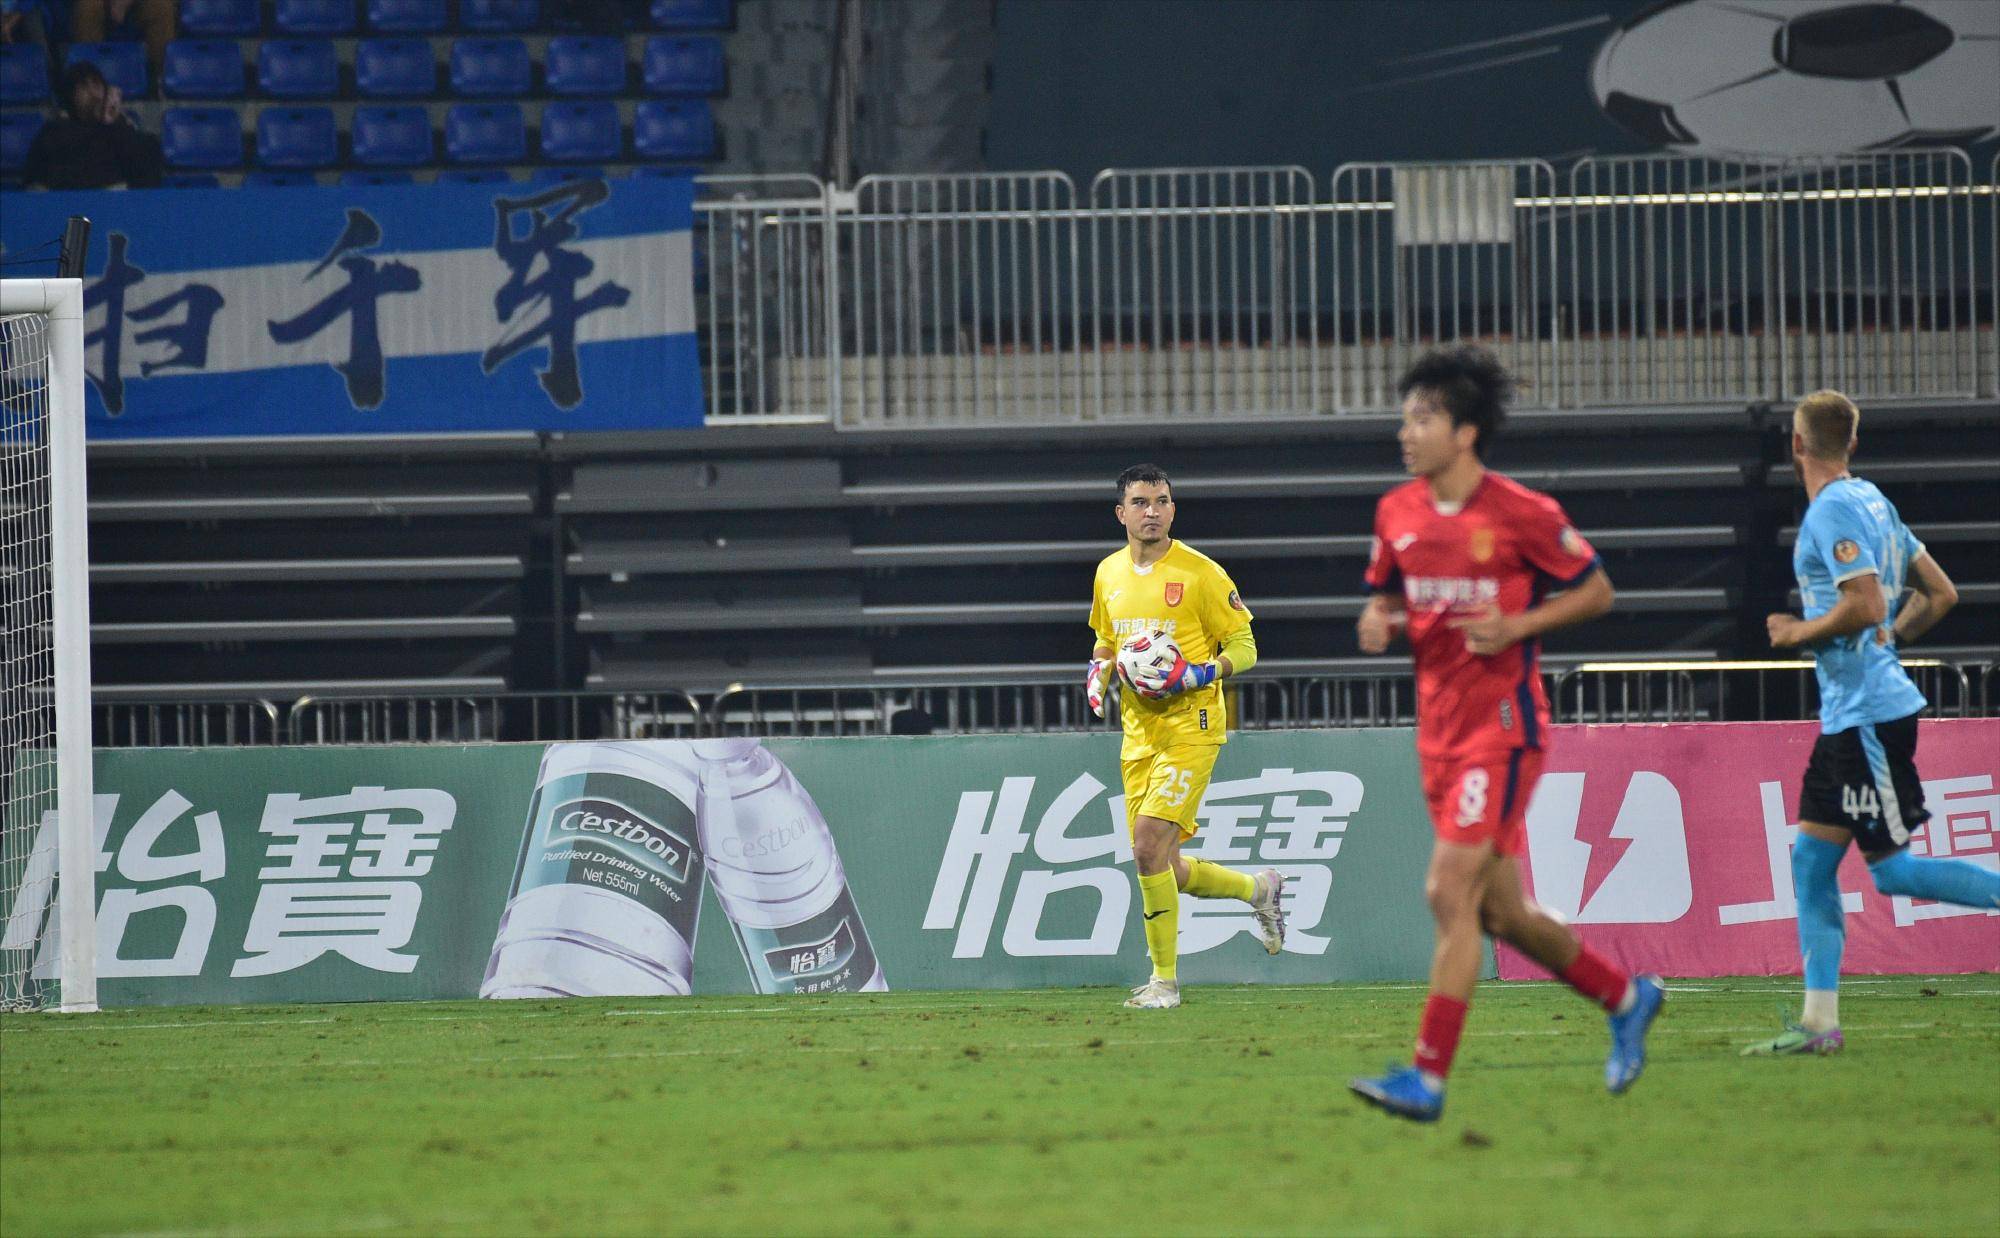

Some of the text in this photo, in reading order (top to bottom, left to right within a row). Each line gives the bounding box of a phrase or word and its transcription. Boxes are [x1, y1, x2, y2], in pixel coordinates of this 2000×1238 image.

[1159, 766, 1193, 807] 25
[1456, 766, 1490, 827] 8
[1842, 784, 1880, 821] 44
[582, 867, 640, 896] Net 555ml
[592, 851, 648, 879] Drinking
[649, 873, 683, 903] Water
